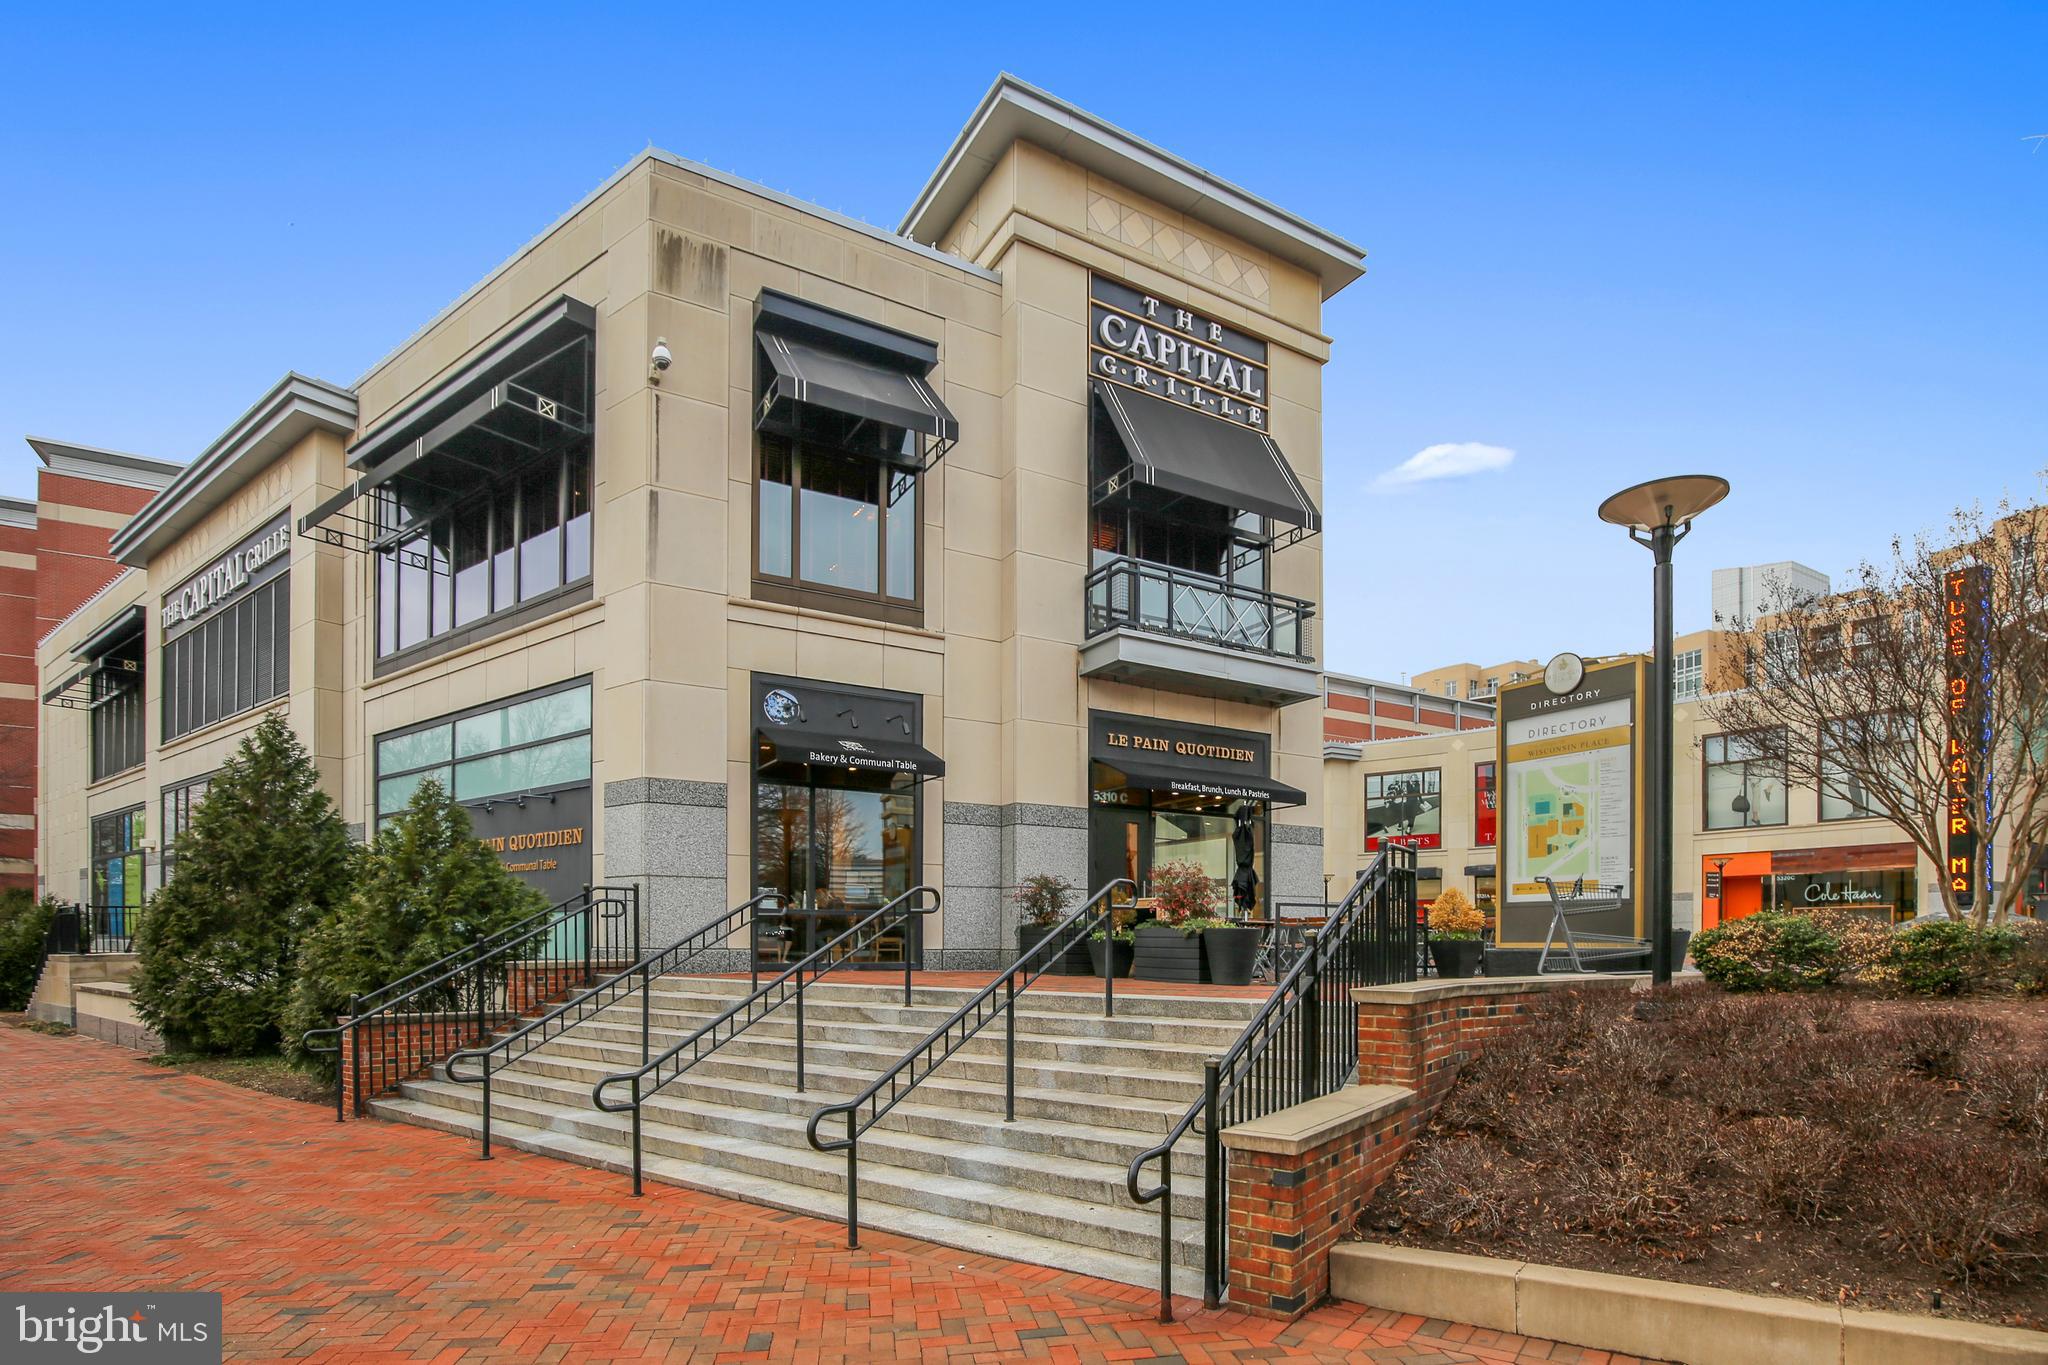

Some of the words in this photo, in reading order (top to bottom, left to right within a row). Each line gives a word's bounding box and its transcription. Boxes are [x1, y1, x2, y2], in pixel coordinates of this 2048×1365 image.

[1143, 296, 1222, 343] THE
[1100, 314, 1262, 399] CAPITAL
[161, 600, 181, 629] THE
[181, 551, 249, 620] CAPITAL
[245, 524, 291, 573] GRILLE
[1530, 689, 1601, 711] DIRECTORY
[1528, 715, 1607, 739] DIRECTORY
[1108, 733, 1129, 747] LE
[1133, 735, 1169, 752] PAIN
[1175, 741, 1255, 762] QUOTIDIEN
[1528, 743, 1577, 758] WISCONSIN
[1580, 738, 1610, 750] PLACE
[810, 751, 838, 765] Bakery
[840, 755, 848, 763] &
[849, 756, 894, 768] Communal
[895, 760, 917, 770] Table
[1120, 792, 1129, 804] C
[1171, 781, 1200, 793] Breakfast,
[1202, 783, 1224, 795] Brunch,
[1224, 785, 1241, 796] Lunch
[1242, 788, 1248, 796] &
[1248, 789, 1270, 799] Pastries
[509, 827, 584, 852] QUOTIDIEN
[505, 861, 538, 873] Communal
[539, 858, 557, 870] Table
[1804, 882, 1840, 902] Cole
[1841, 880, 1882, 903] Haan
